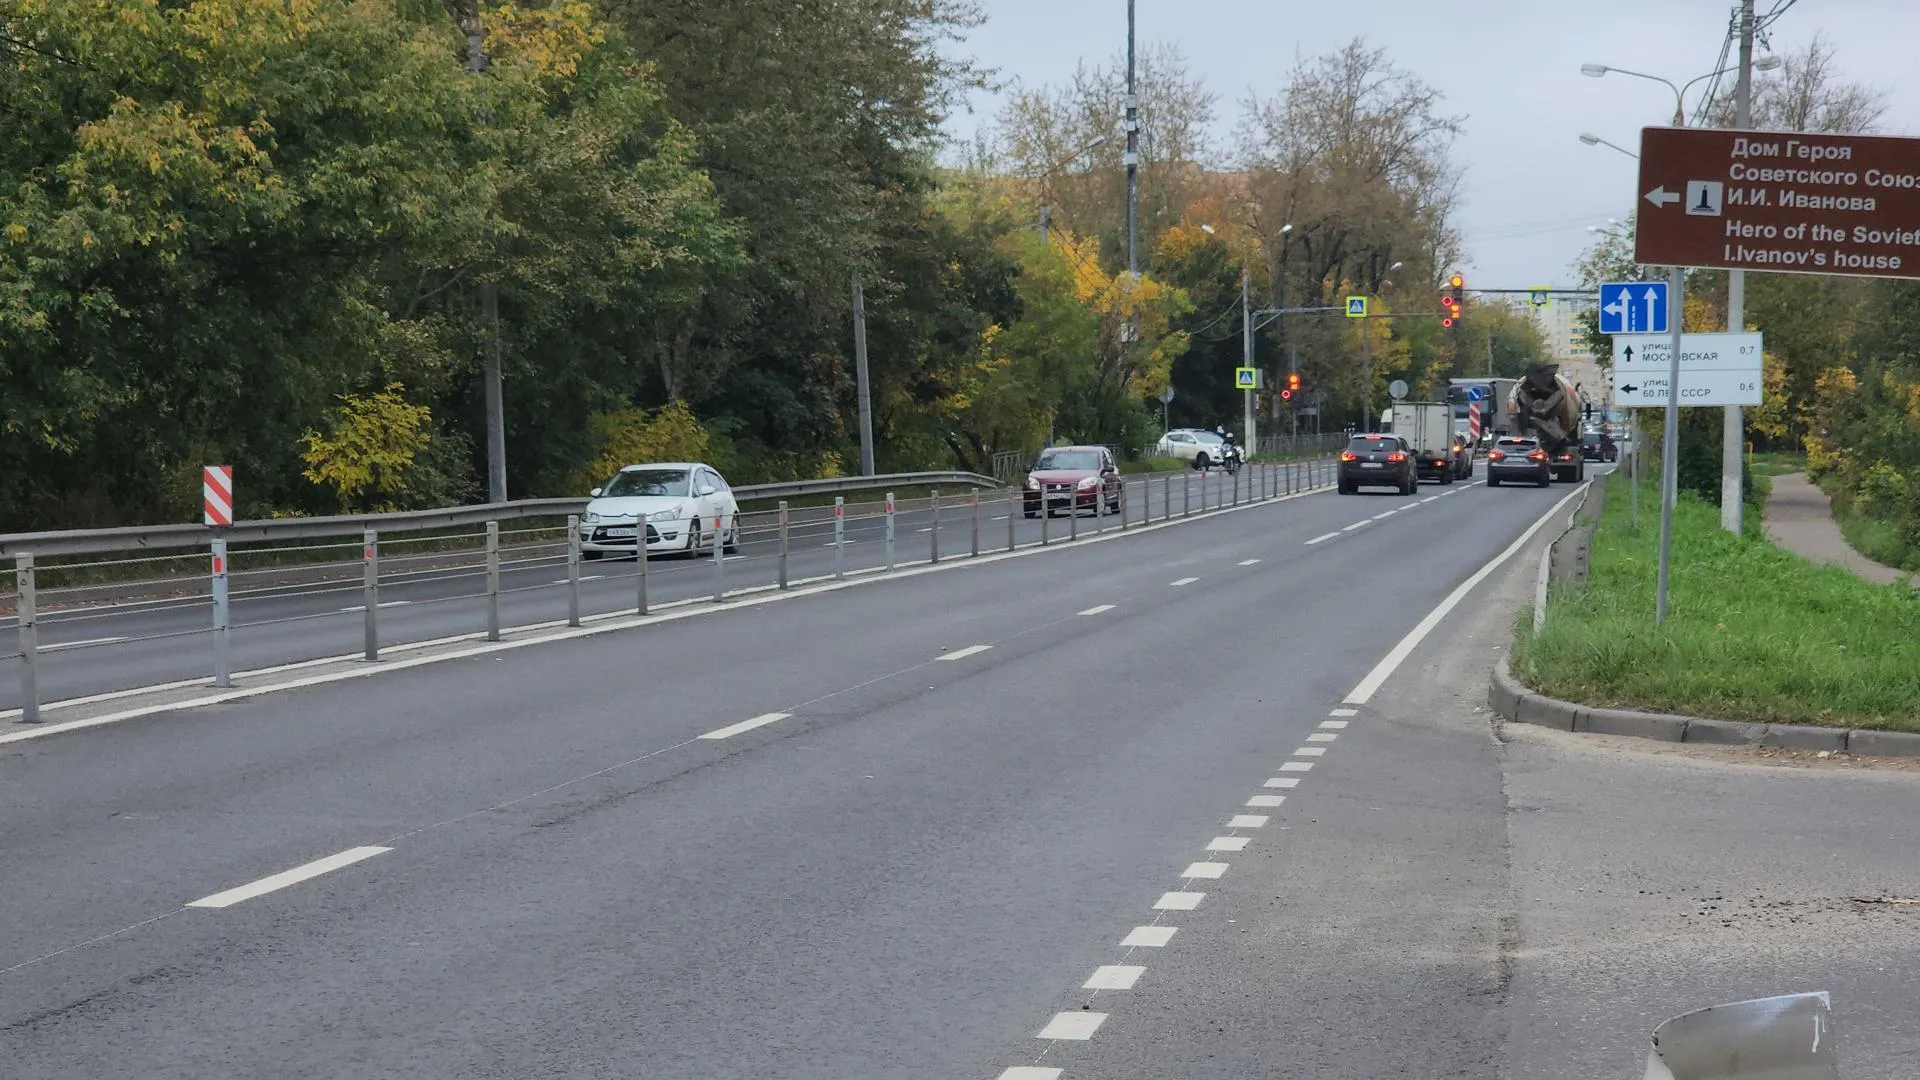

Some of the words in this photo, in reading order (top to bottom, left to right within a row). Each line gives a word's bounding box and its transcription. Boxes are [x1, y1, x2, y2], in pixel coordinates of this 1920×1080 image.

[1731, 138, 1779, 159] Дом
[1786, 140, 1852, 162] Героя
[1729, 163, 1858, 186] Советского
[1727, 187, 1772, 206] И.И.
[1779, 189, 1876, 211] Иванова
[1725, 219, 1777, 239] Hero
[1783, 223, 1807, 239] of
[1811, 224, 1846, 242] the
[1852, 226, 1920, 245] Soviet
[1833, 250, 1901, 269] house
[1642, 353, 1718, 361] МОСКВСКАЯ
[1681, 389, 1711, 397] СССР
